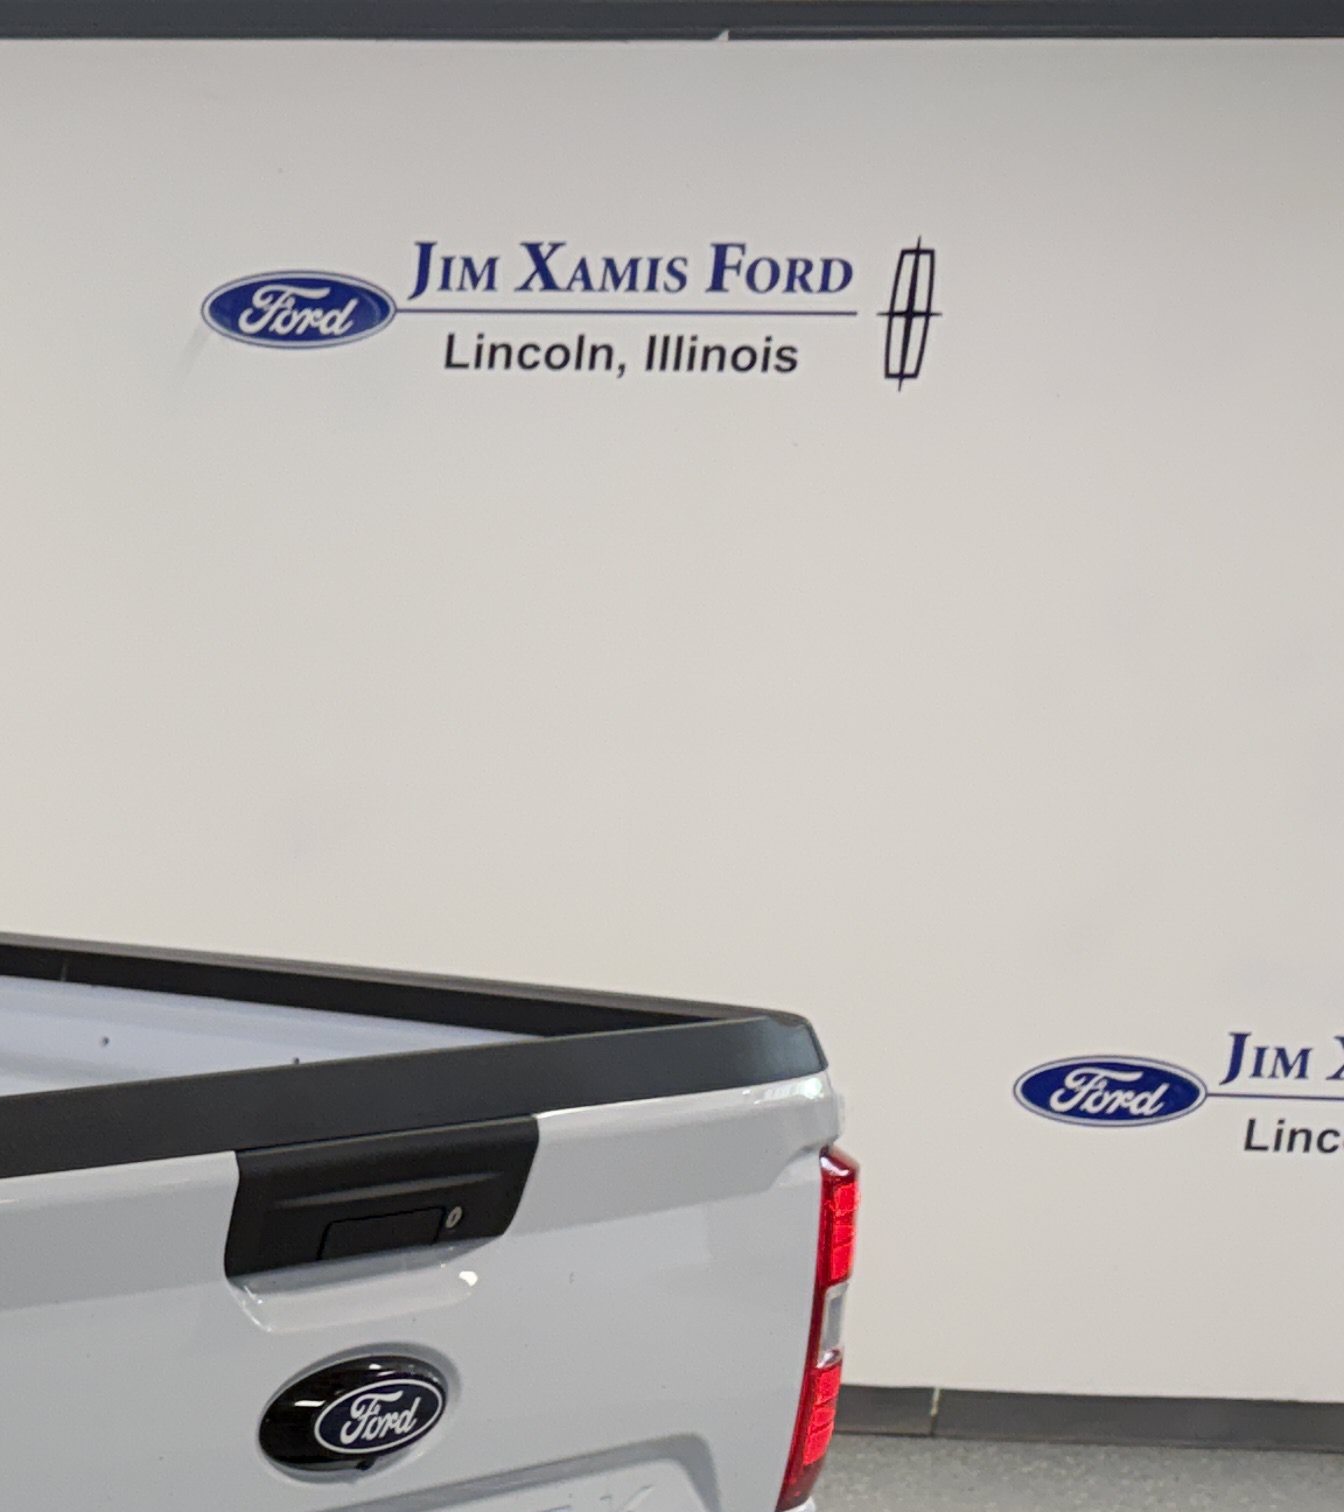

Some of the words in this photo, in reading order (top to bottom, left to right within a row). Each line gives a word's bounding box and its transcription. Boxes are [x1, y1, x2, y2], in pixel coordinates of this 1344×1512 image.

[407, 241, 501, 300] JIM
[513, 241, 689, 293] XAMIS
[704, 242, 854, 294] FORD
[444, 333, 627, 379] Lincoln,
[645, 335, 799, 374] Illinois
[1219, 1031, 1314, 1086] JIM
[1243, 1118, 1344, 1154] Linc
[340, 1390, 422, 1445] Ford
